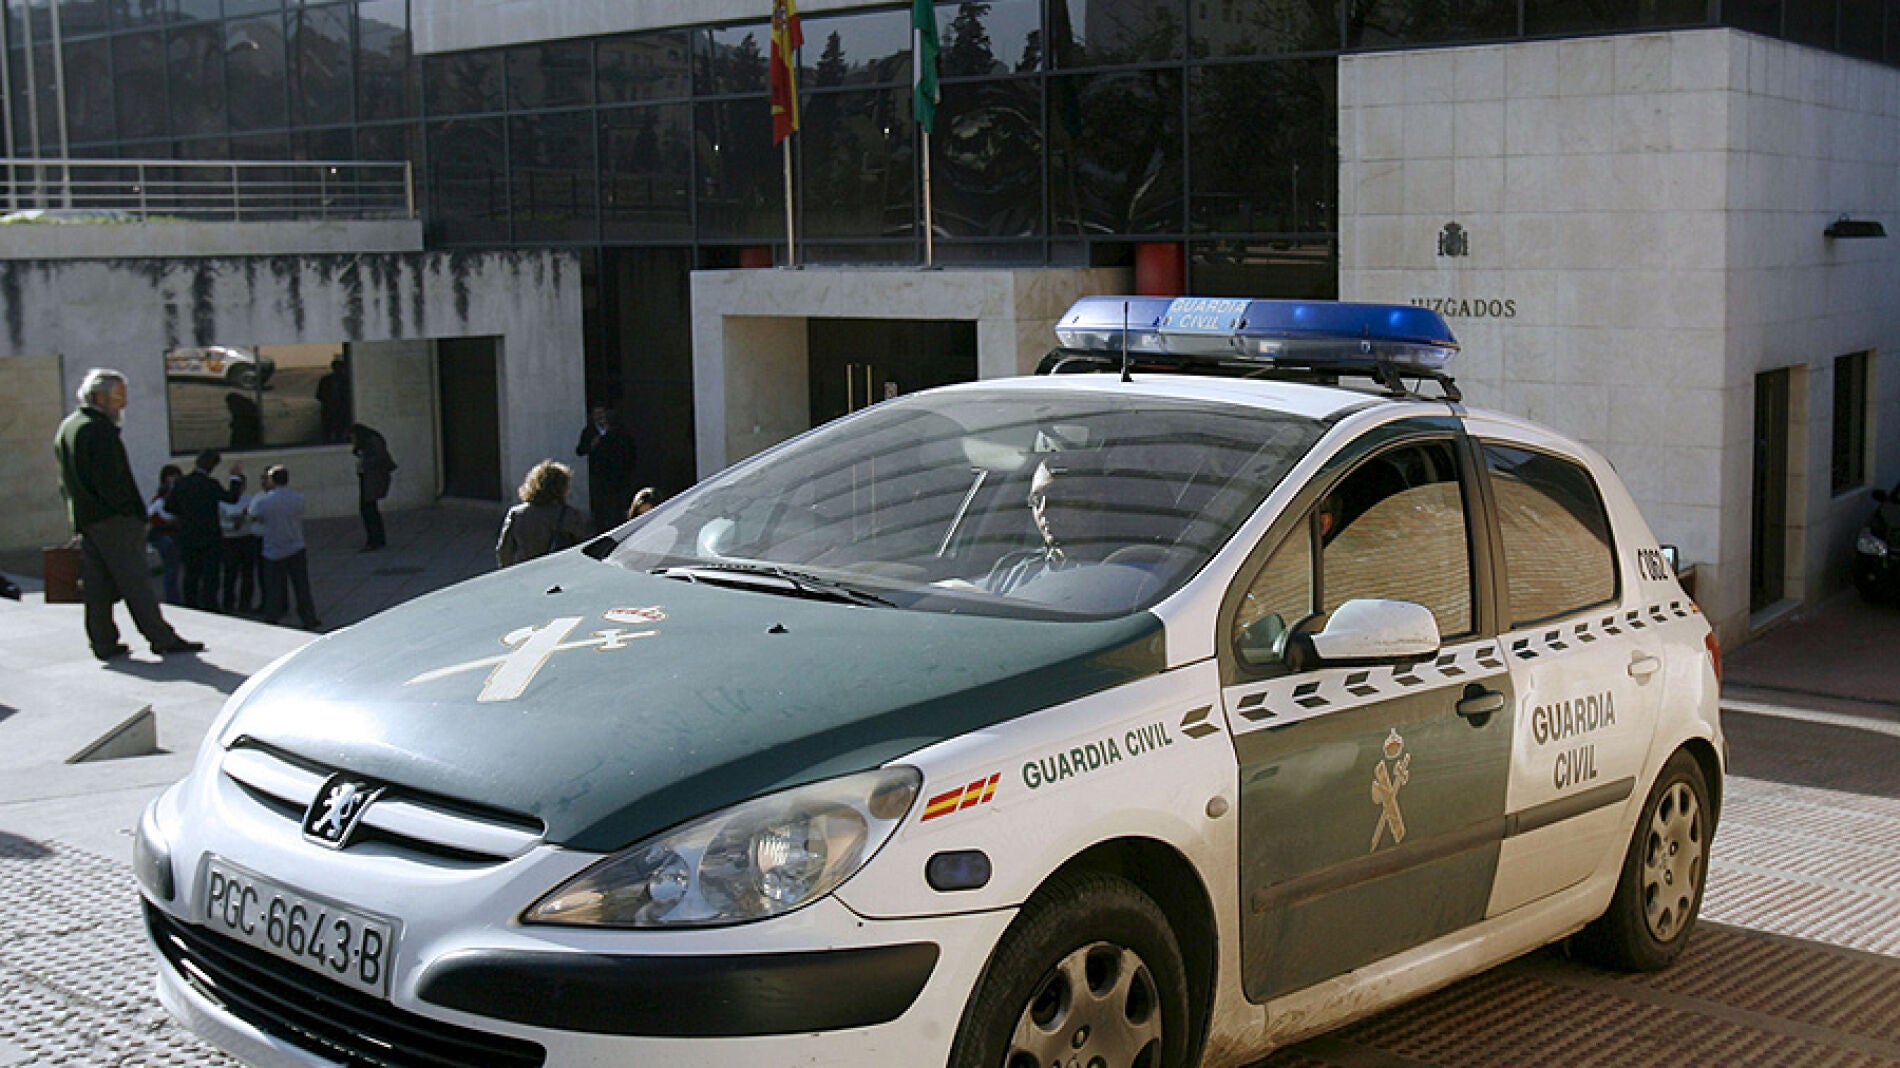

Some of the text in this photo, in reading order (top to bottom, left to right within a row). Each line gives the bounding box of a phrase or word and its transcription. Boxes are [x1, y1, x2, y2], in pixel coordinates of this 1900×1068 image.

[1171, 299, 1246, 313] GUARDIA
[1179, 313, 1219, 329] CIVIL
[1532, 690, 1616, 745] GUARDIA
[1022, 721, 1173, 789] GUARDIA CIVIL
[1553, 744, 1598, 790] CIVIL
